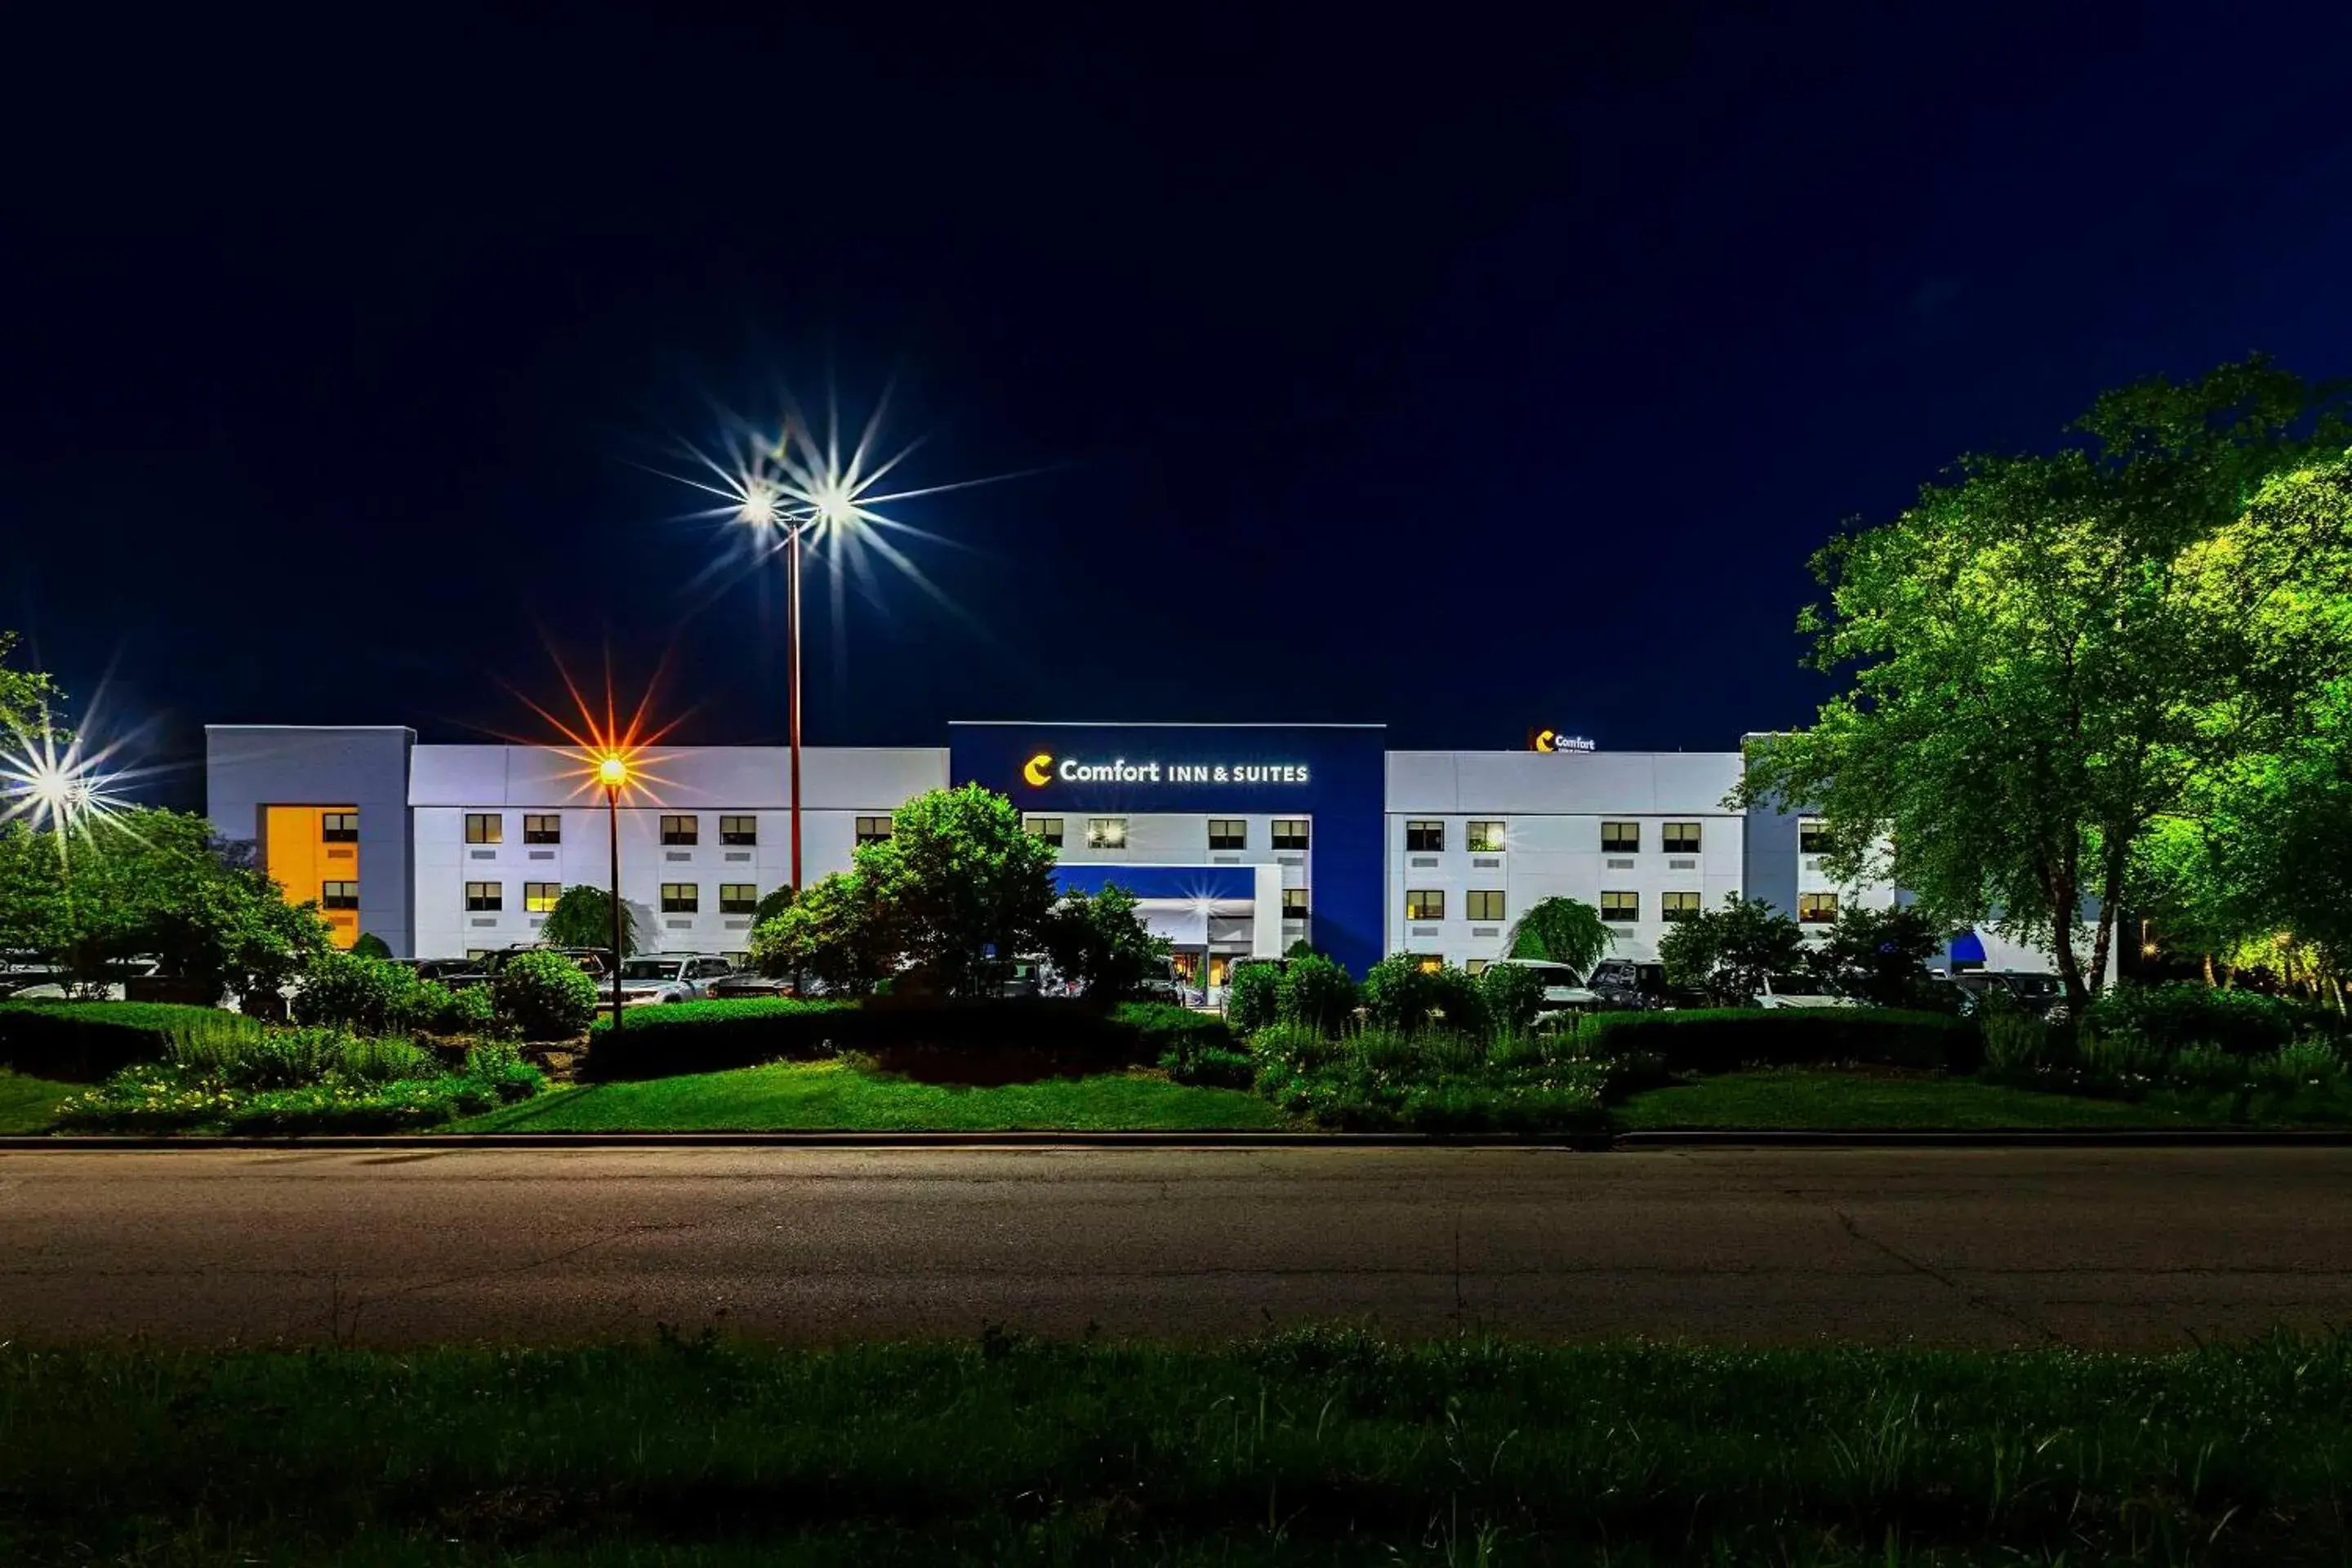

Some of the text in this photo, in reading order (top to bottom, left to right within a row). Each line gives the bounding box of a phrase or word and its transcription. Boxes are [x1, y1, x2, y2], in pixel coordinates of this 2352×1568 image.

[1556, 736, 1595, 750] Comfort
[1059, 760, 1308, 782] Comfort INN & SUITES
